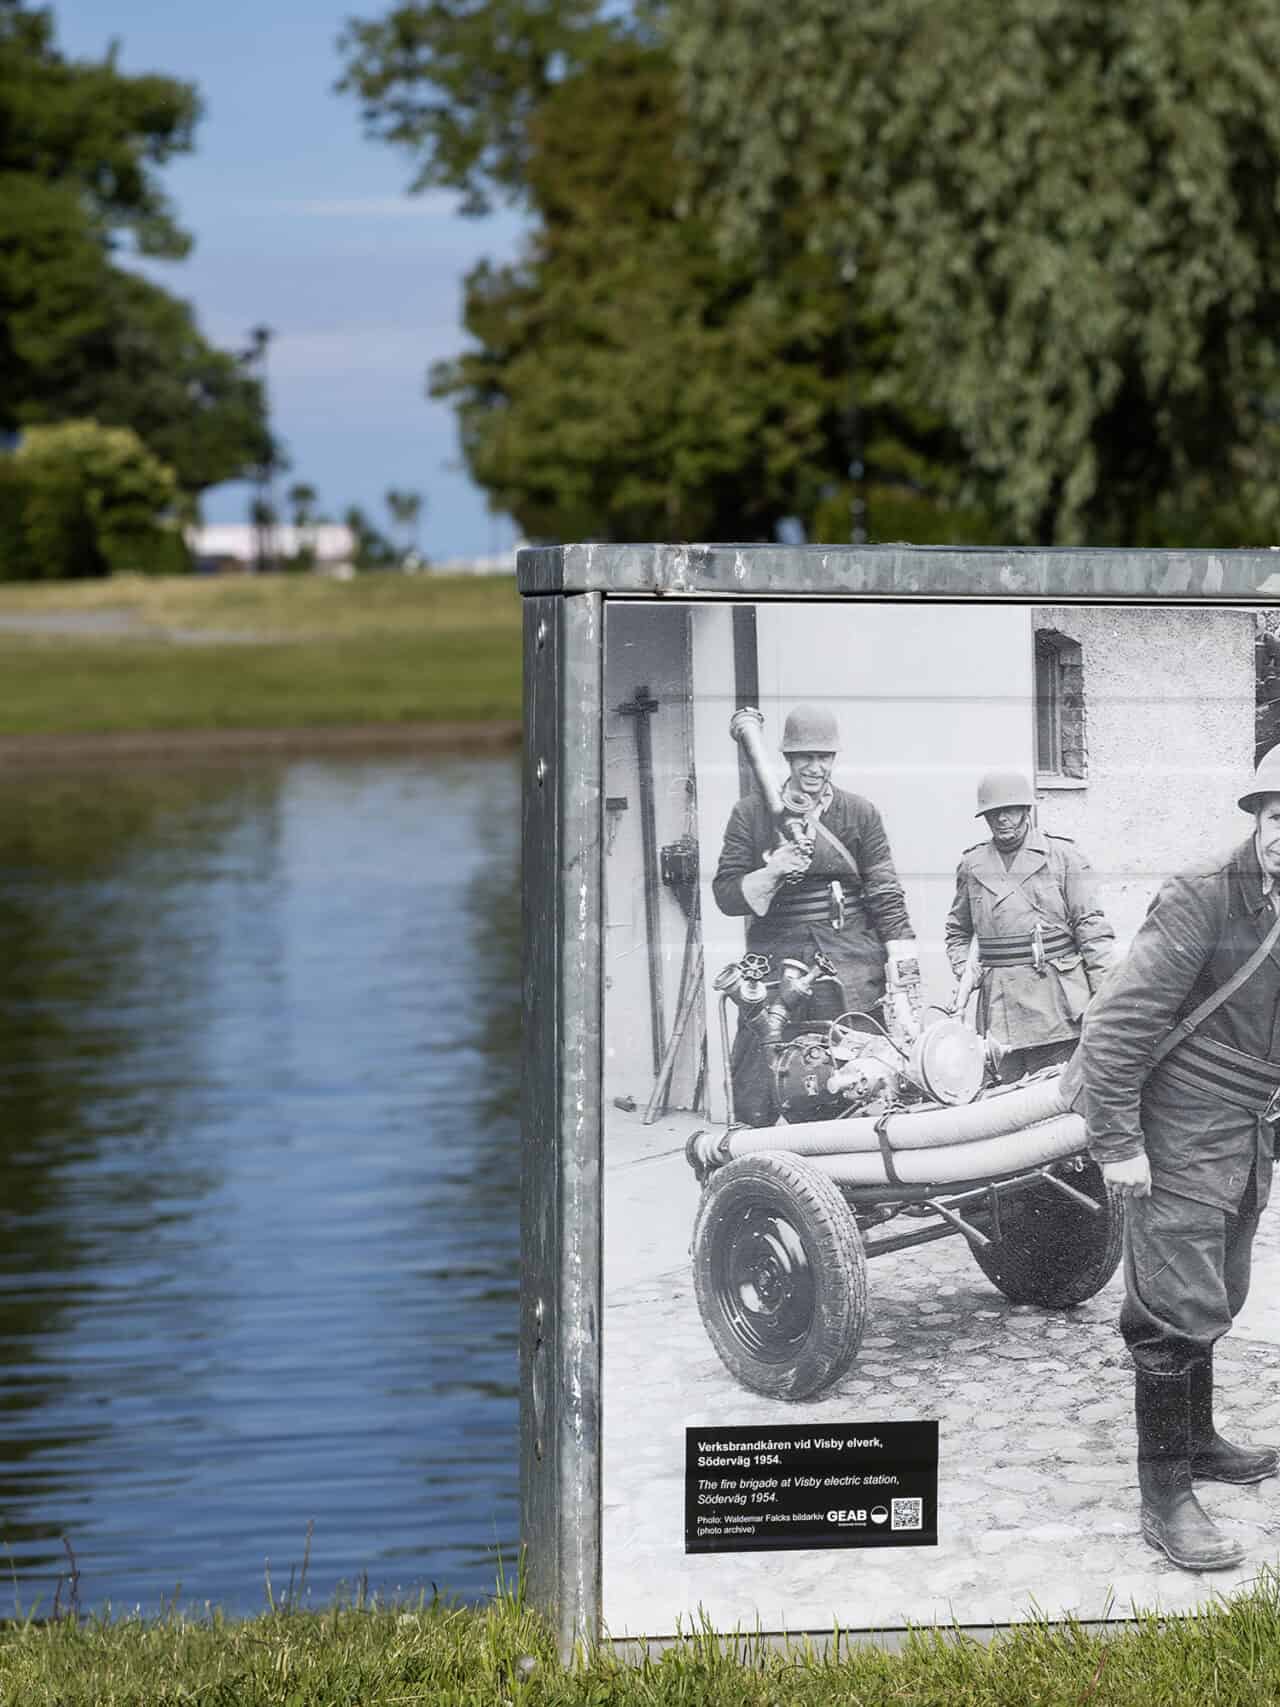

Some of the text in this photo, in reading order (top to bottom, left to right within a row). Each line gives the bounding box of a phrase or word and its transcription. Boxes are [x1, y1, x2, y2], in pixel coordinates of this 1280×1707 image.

[698, 1437, 883, 1453] Verksbrandkåren vid Visby elverk,
[698, 1455, 782, 1467] Söderväg 1954.
[698, 1474, 899, 1490] The fire brigade at Visby electric station,
[698, 1493, 779, 1505] Söderväg 1954.
[697, 1512, 824, 1525] Photo: Waldemar Falcks bildarkiv
[827, 1510, 867, 1522] GEAB
[697, 1525, 755, 1536] (photo archive)
